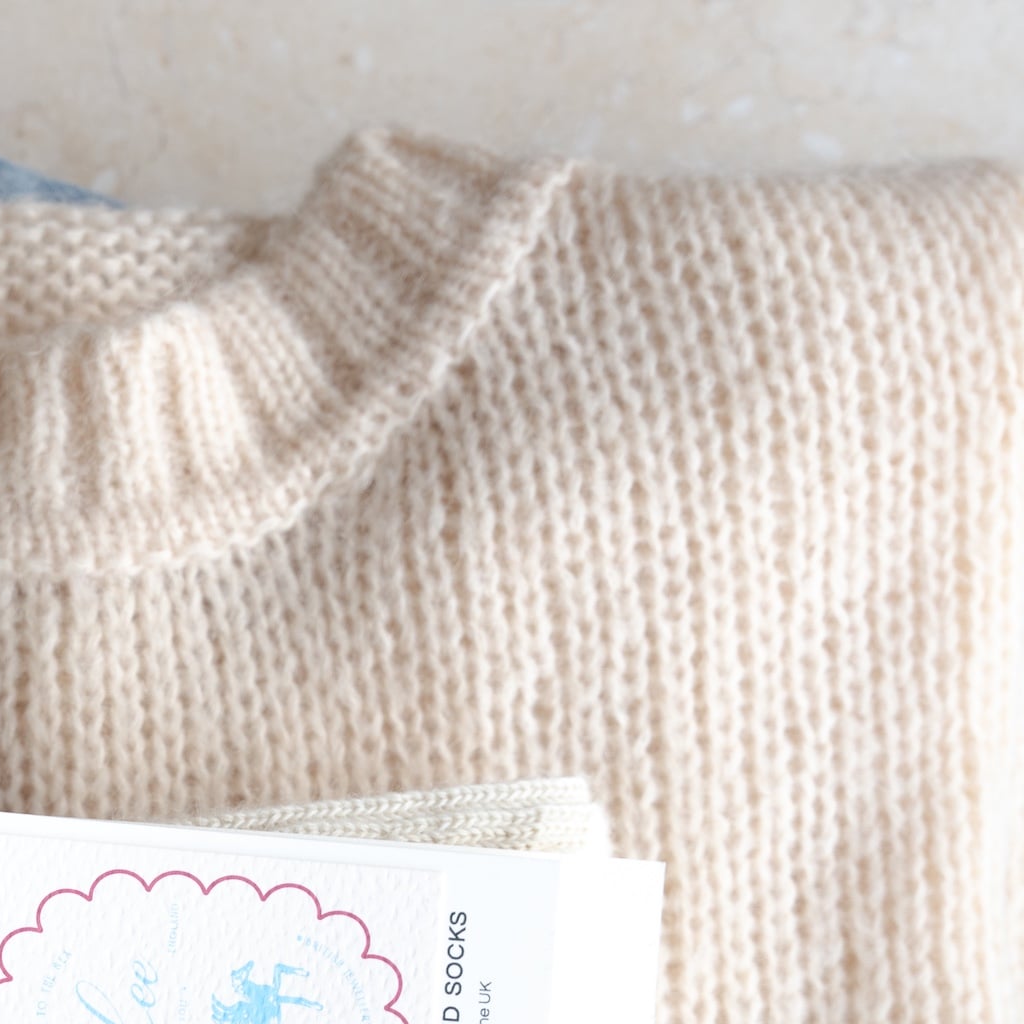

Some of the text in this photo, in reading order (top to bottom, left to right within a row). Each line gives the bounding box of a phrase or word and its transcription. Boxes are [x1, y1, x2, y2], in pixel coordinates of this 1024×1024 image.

[445, 911, 467, 996] SOCKS
[478, 981, 492, 1004] UK
[35, 999, 47, 1016] TO
